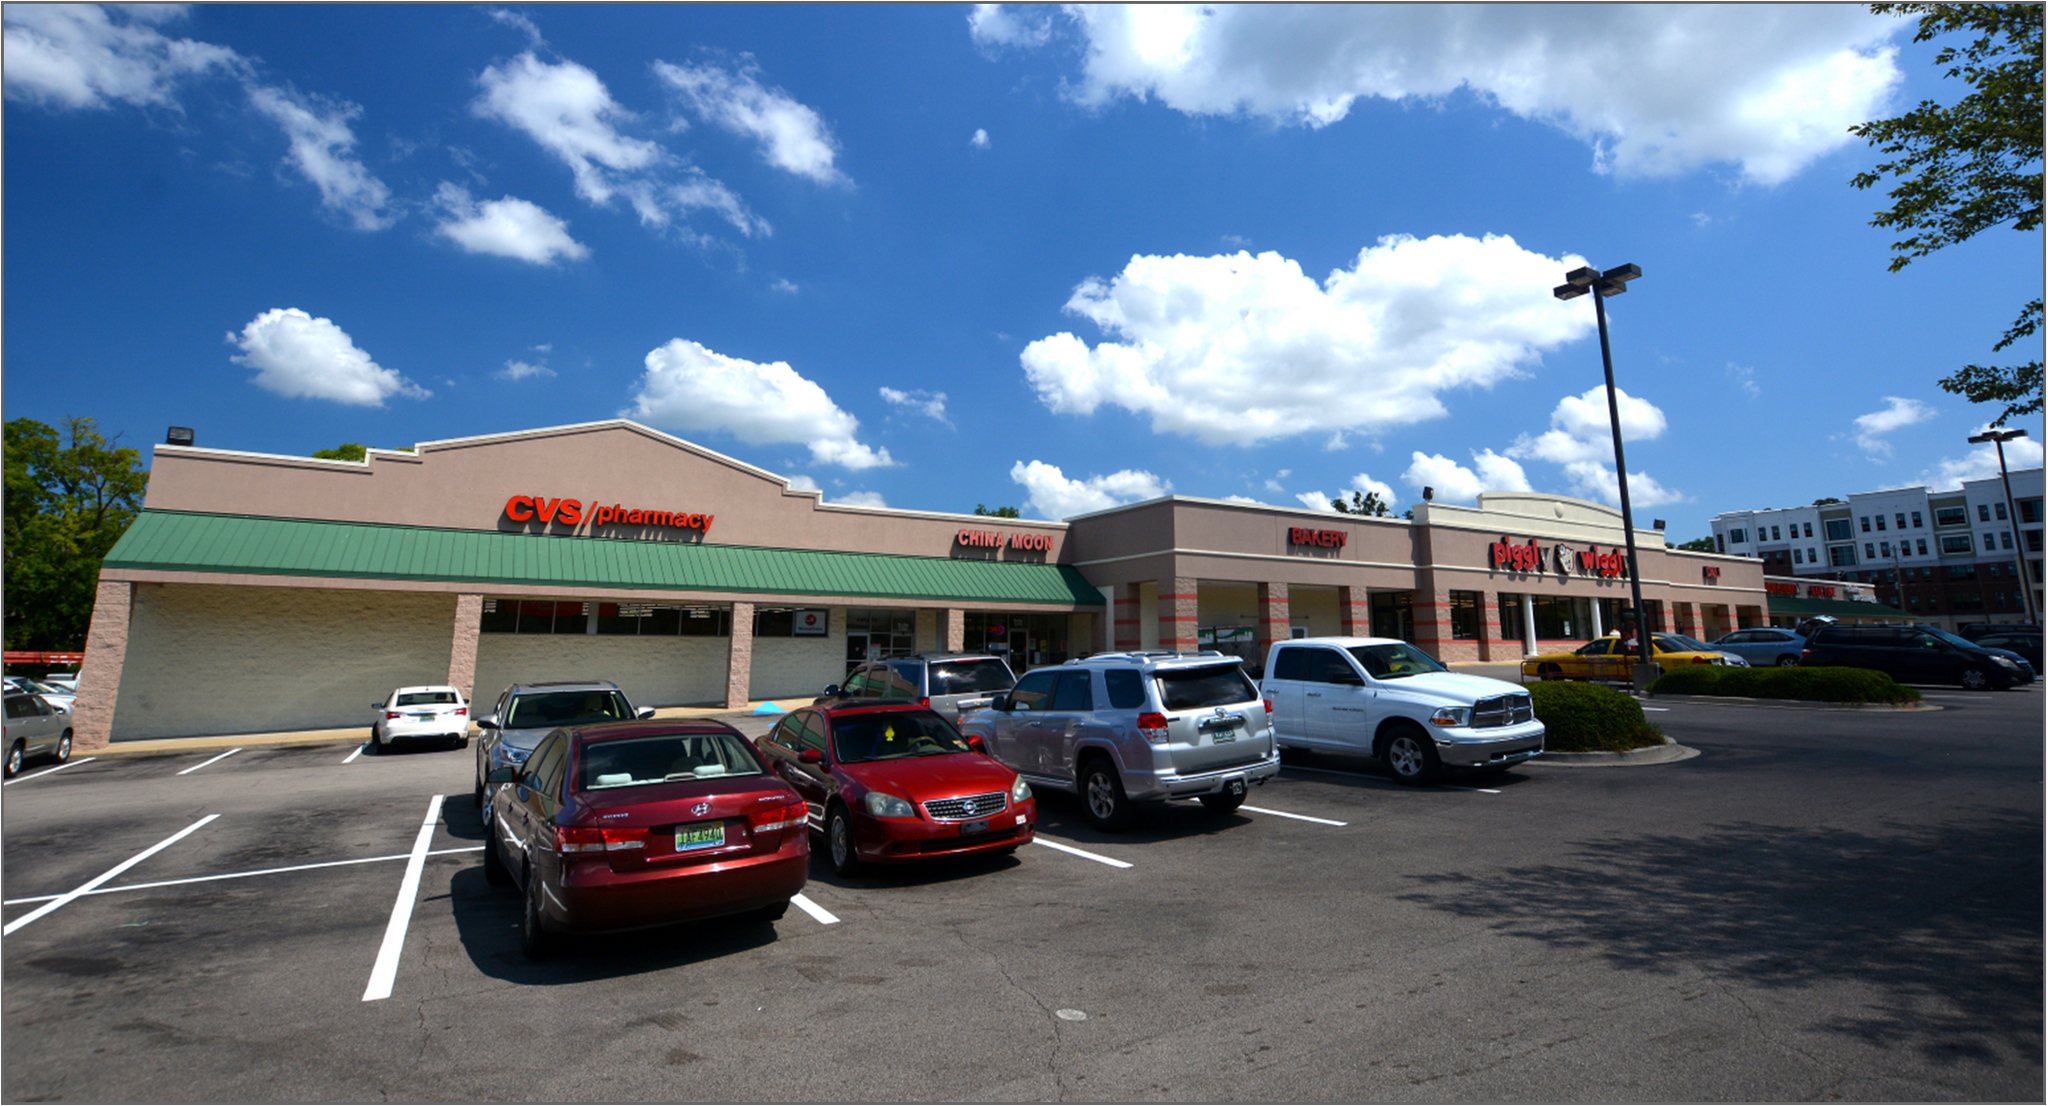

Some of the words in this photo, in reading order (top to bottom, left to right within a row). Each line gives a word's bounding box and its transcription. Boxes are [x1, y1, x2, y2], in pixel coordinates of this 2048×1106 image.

[958, 529, 1005, 547] CHINA
[1011, 533, 1054, 550] MOON
[1292, 526, 1348, 547] BAKERY
